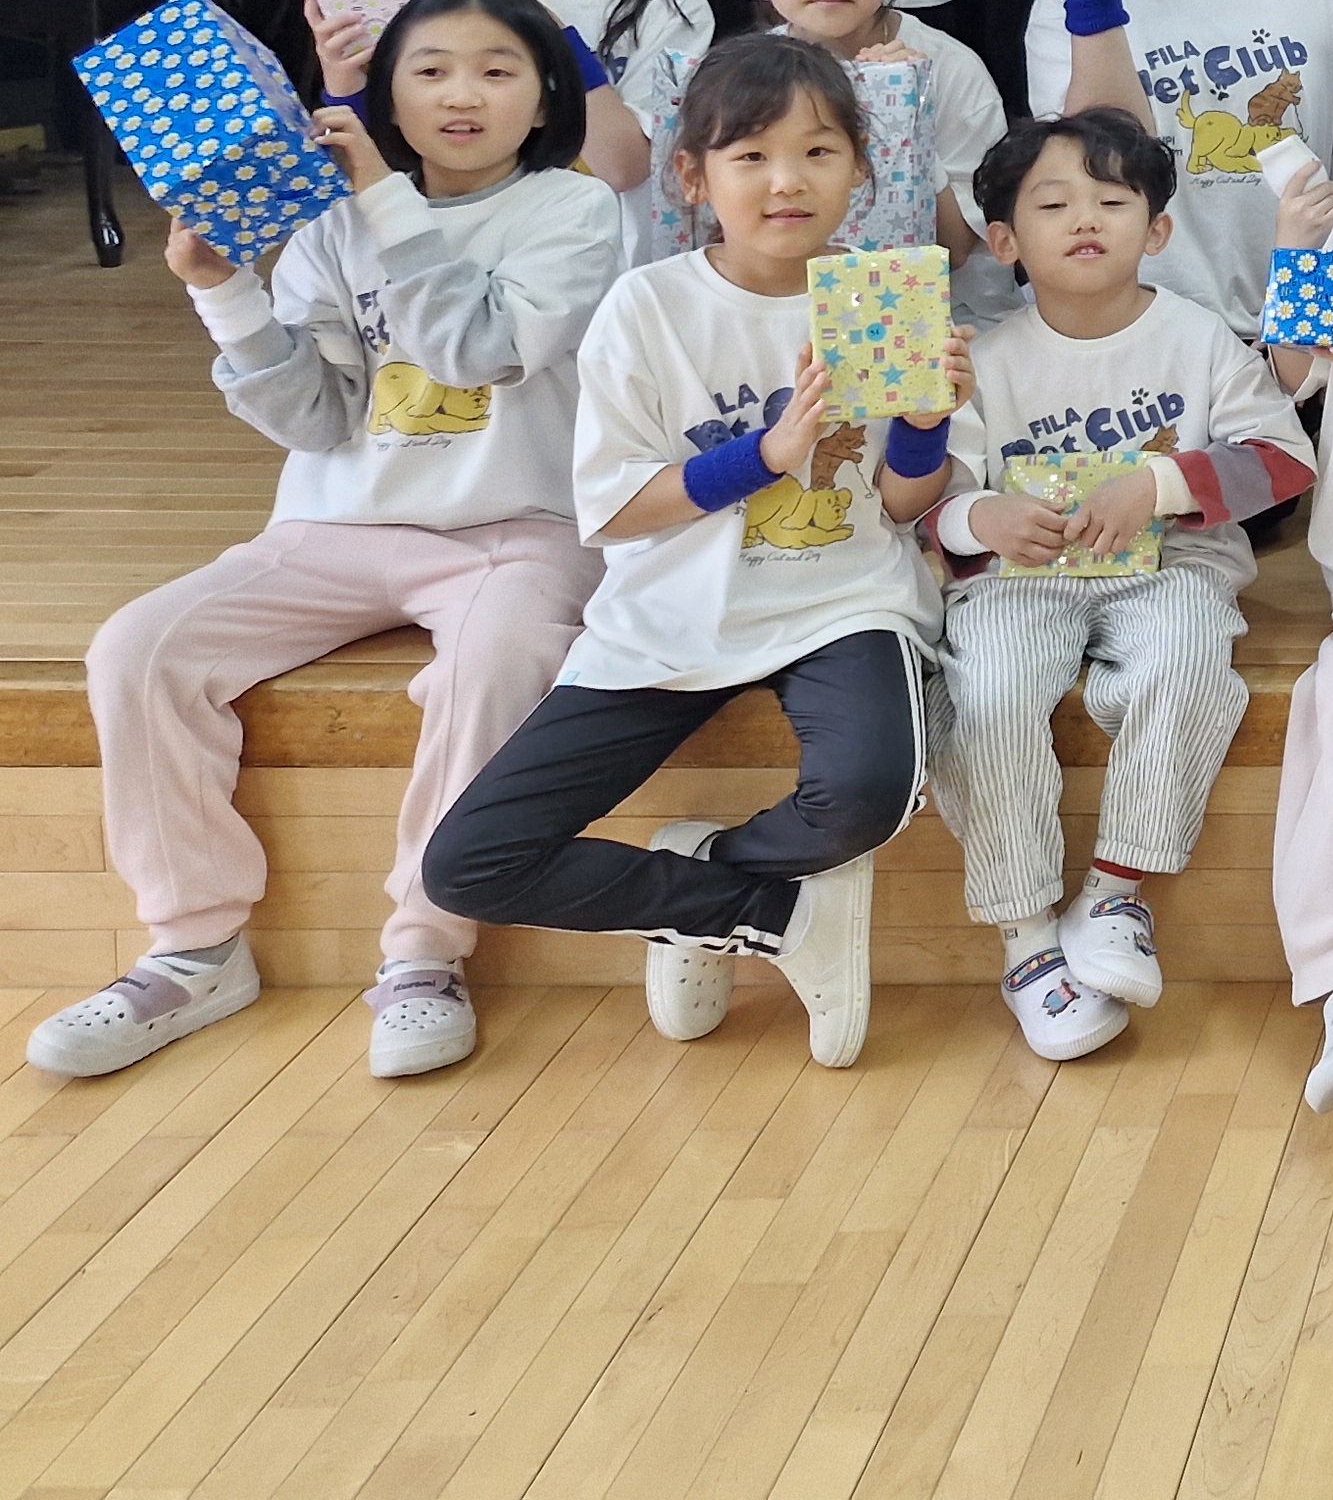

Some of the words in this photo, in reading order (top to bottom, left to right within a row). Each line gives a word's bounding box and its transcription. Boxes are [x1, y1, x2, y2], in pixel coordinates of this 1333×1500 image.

[1145, 40, 1202, 71] FILA
[1203, 36, 1309, 89] Club
[1028, 407, 1083, 440] FILA
[1085, 392, 1186, 451] Club
